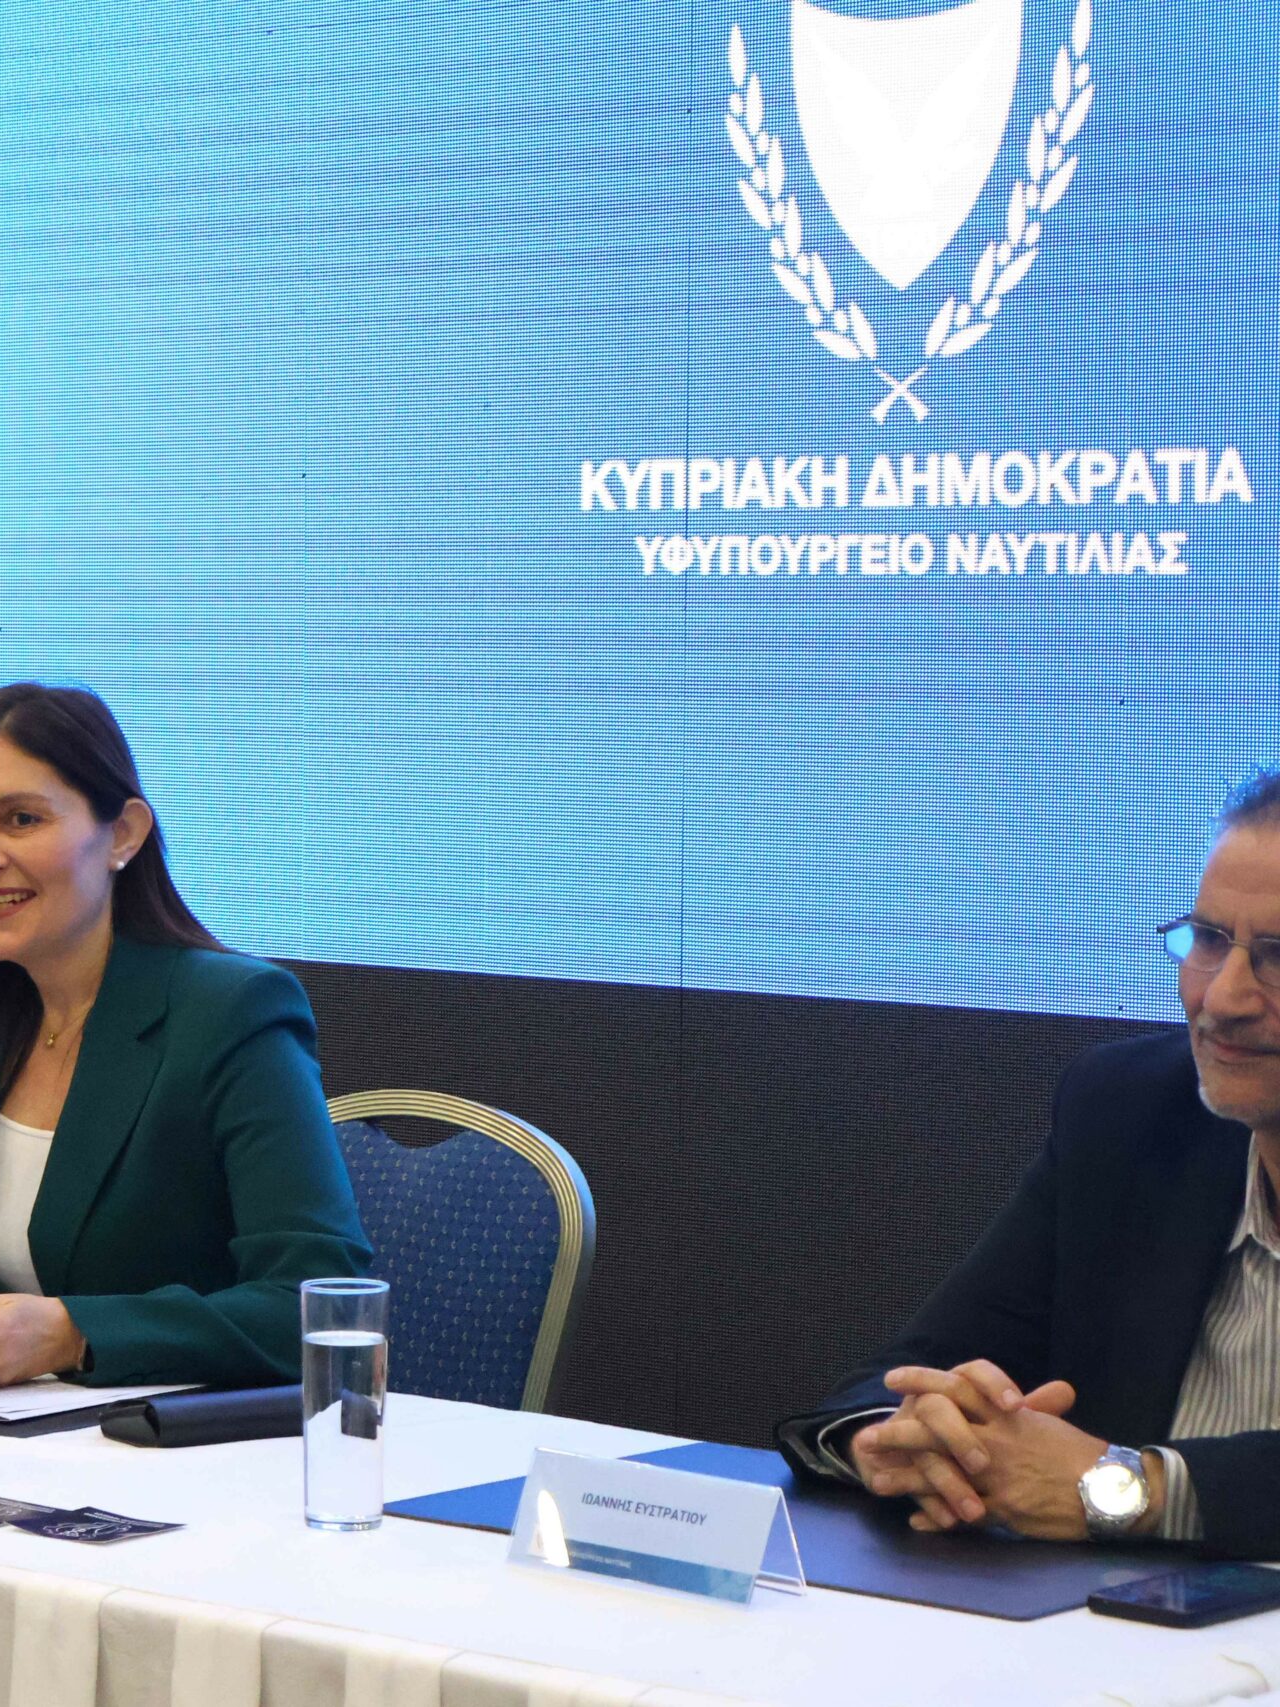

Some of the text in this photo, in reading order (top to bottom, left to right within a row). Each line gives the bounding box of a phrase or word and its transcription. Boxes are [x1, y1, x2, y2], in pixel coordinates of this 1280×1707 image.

[580, 447, 1254, 511] ΚΥΠΡΙΑΚΗ ΔΗΜΟΚΡΑΤΙΑ
[635, 532, 1190, 576] ΥΦΥΠΟΥΡΓΕΙΟ ΝΑΥΤΙΛΙΑΣ
[582, 1493, 707, 1526] ΙΩΑΝΝΗΣ ΕΥΣΤΡΑΤΙΟΥ
